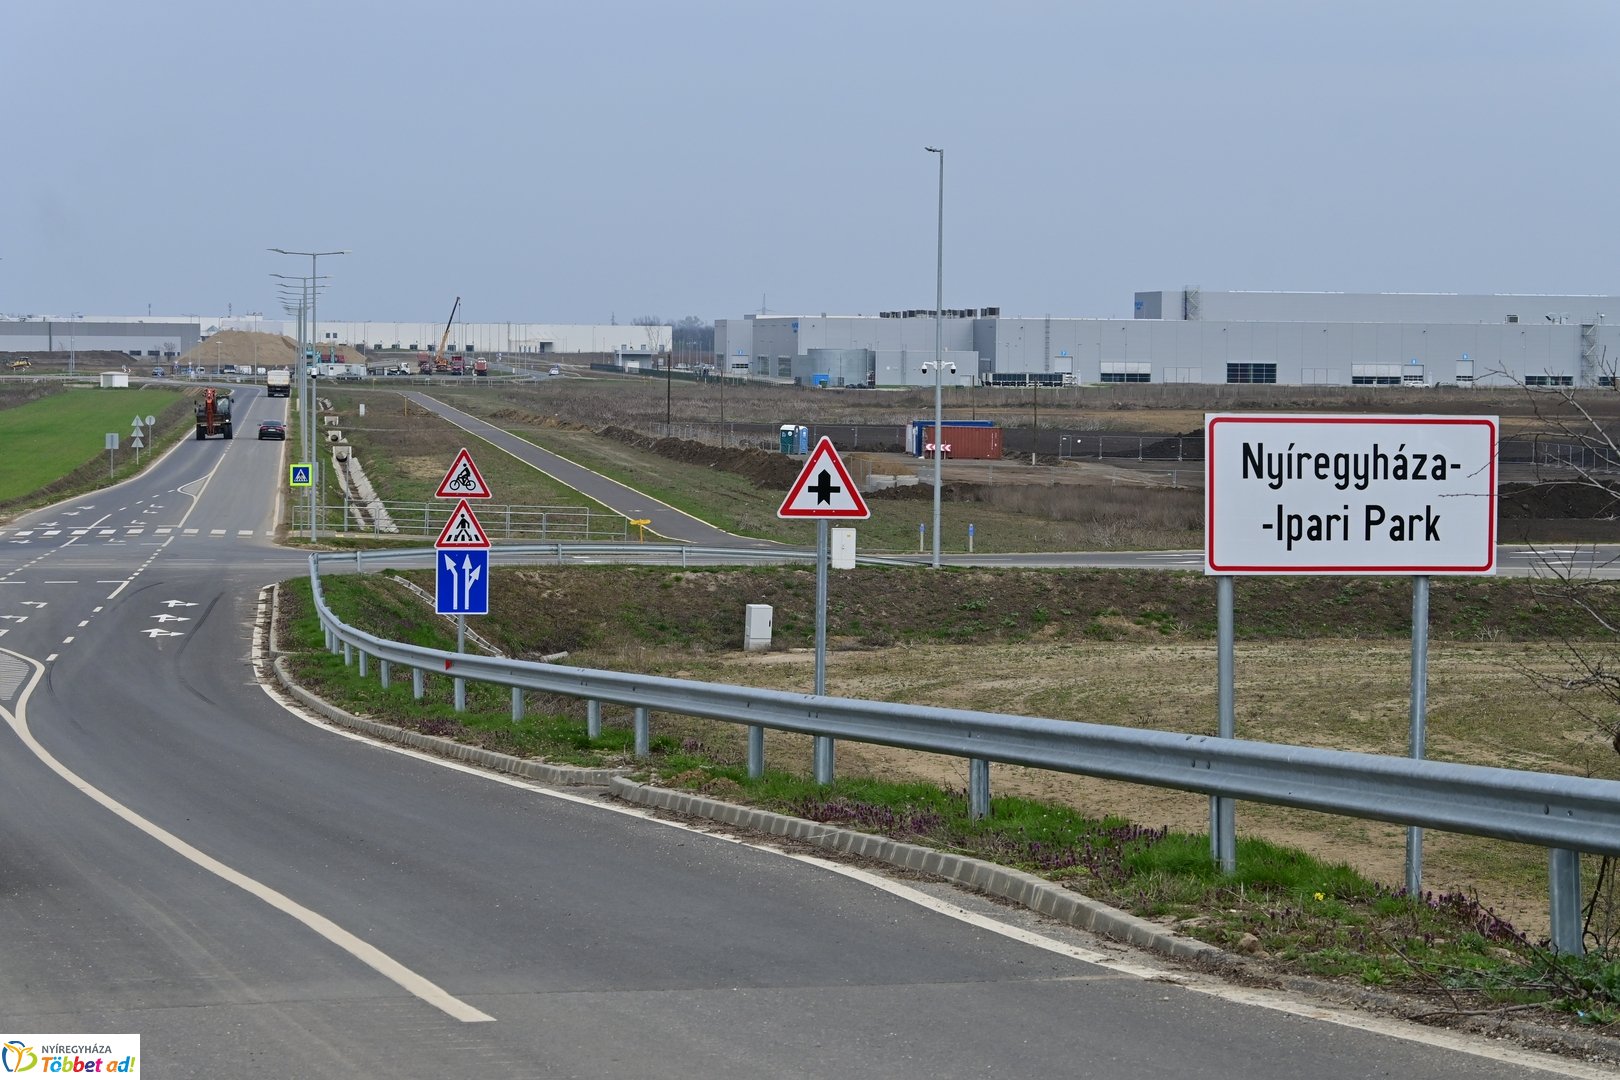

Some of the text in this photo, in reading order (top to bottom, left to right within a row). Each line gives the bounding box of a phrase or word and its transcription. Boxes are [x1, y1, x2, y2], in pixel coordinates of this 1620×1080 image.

[1243, 443, 1460, 490] Nyíregyháza-
[1263, 504, 1440, 551] -Ipari Park
